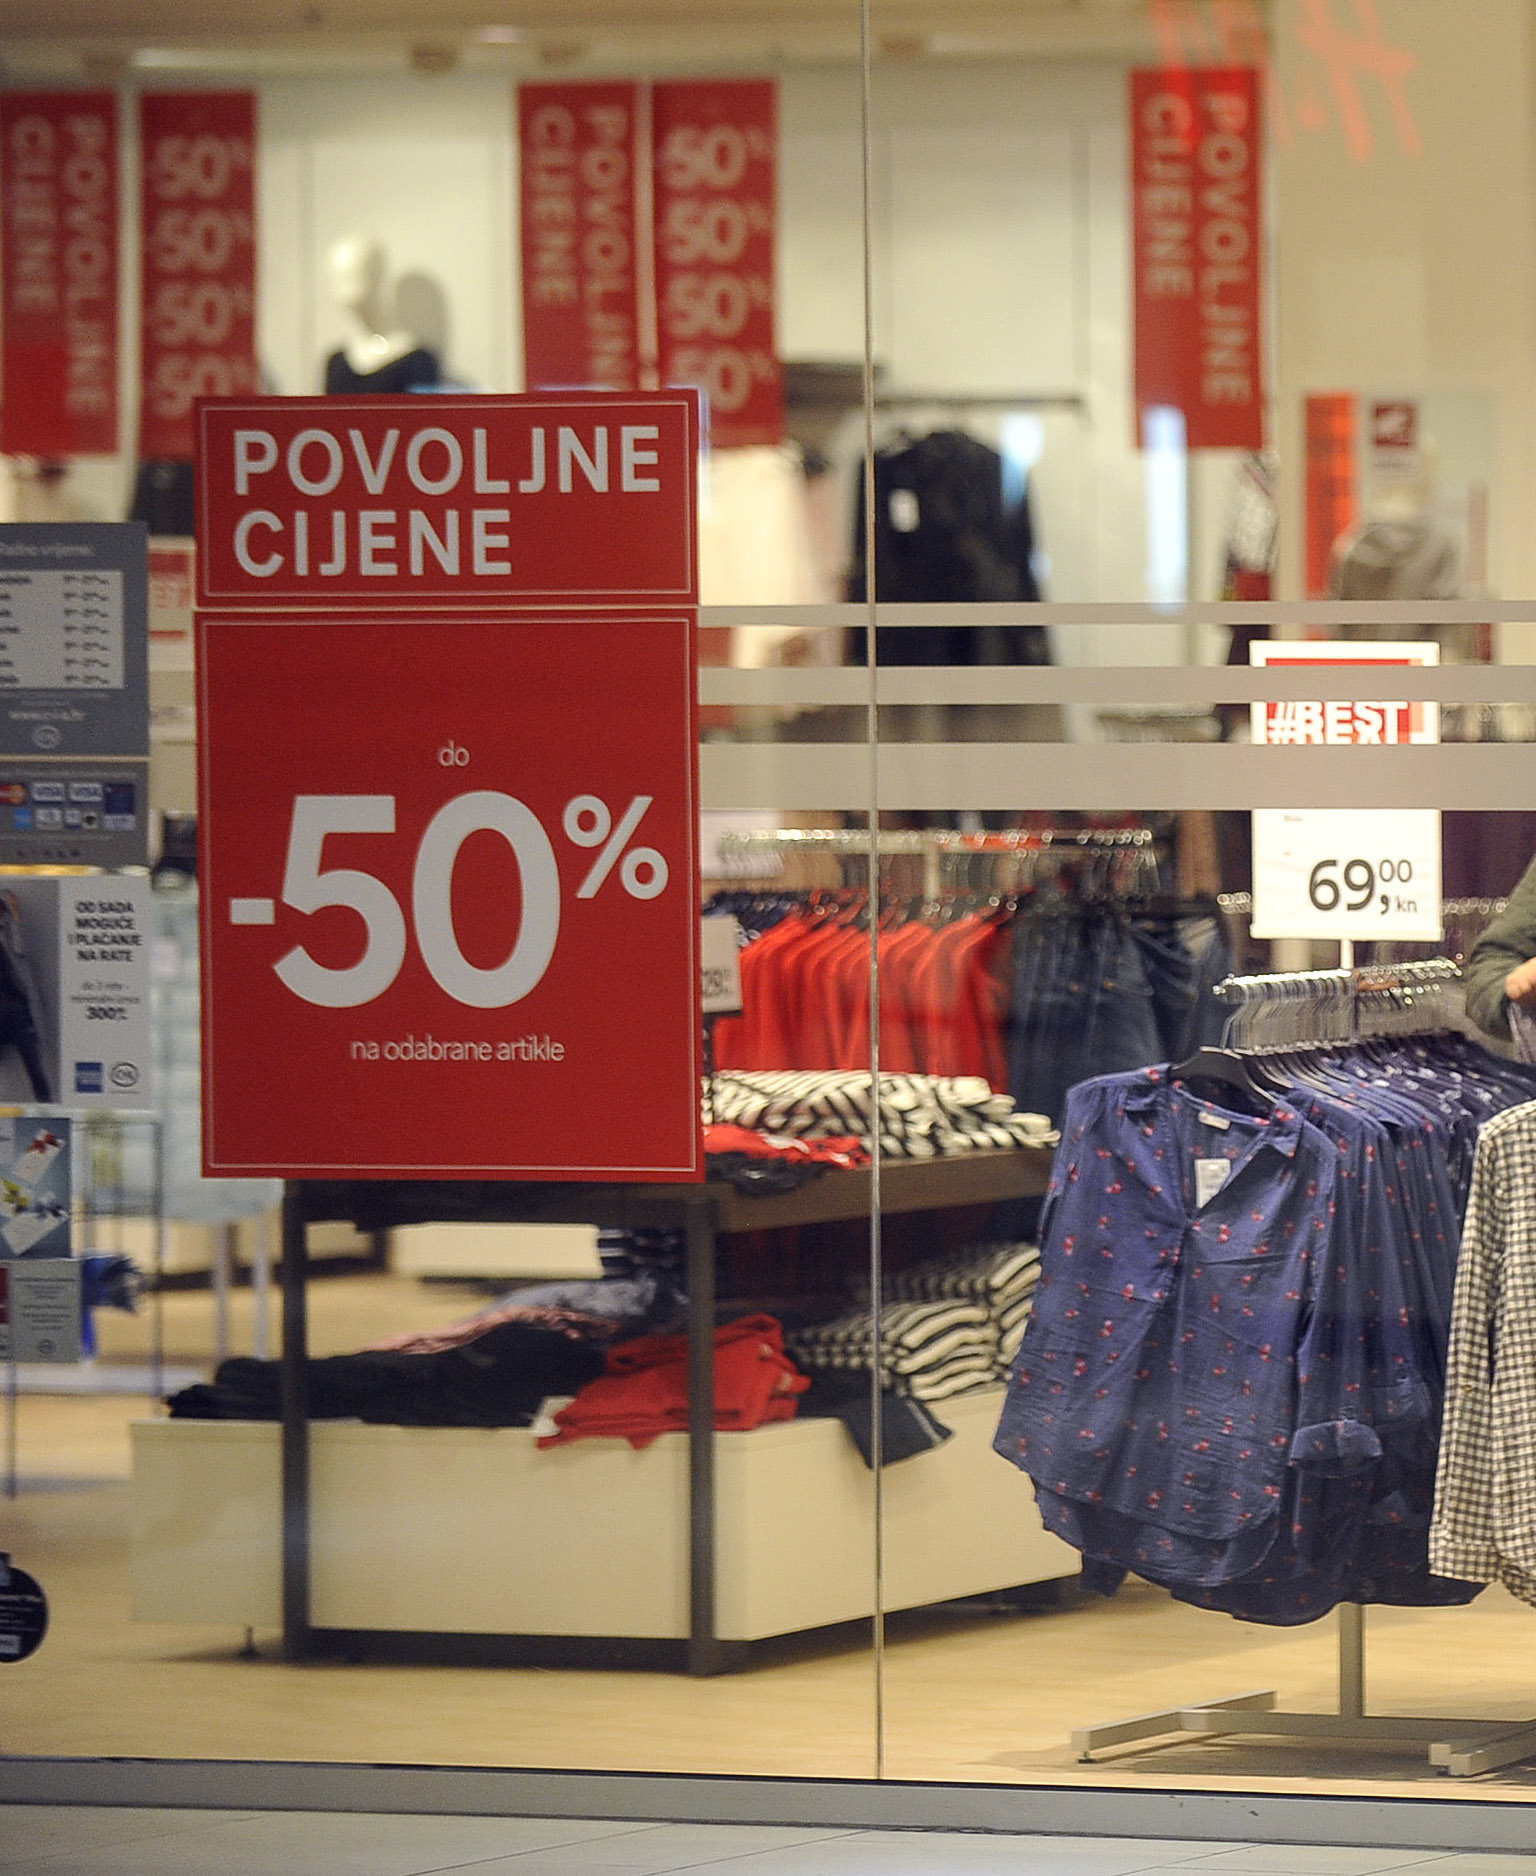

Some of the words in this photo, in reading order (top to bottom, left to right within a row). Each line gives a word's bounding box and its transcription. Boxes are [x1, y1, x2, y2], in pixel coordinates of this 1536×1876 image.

[531, 103, 578, 305] CIJENE
[1142, 92, 1196, 298] CIJENE
[582, 103, 633, 388] POVOLJN
[1200, 92, 1252, 403] POVOLJNE
[234, 426, 660, 496] POVOLJNE
[234, 509, 511, 577] CIJENE
[438, 741, 470, 767] do
[230, 790, 669, 1008] -50%
[1397, 896, 1418, 913] kn
[78, 950, 96, 961] NA
[100, 950, 134, 962] RATE
[351, 1040, 380, 1060] na
[384, 1033, 493, 1061] odabrane
[497, 1034, 565, 1061] artikle
